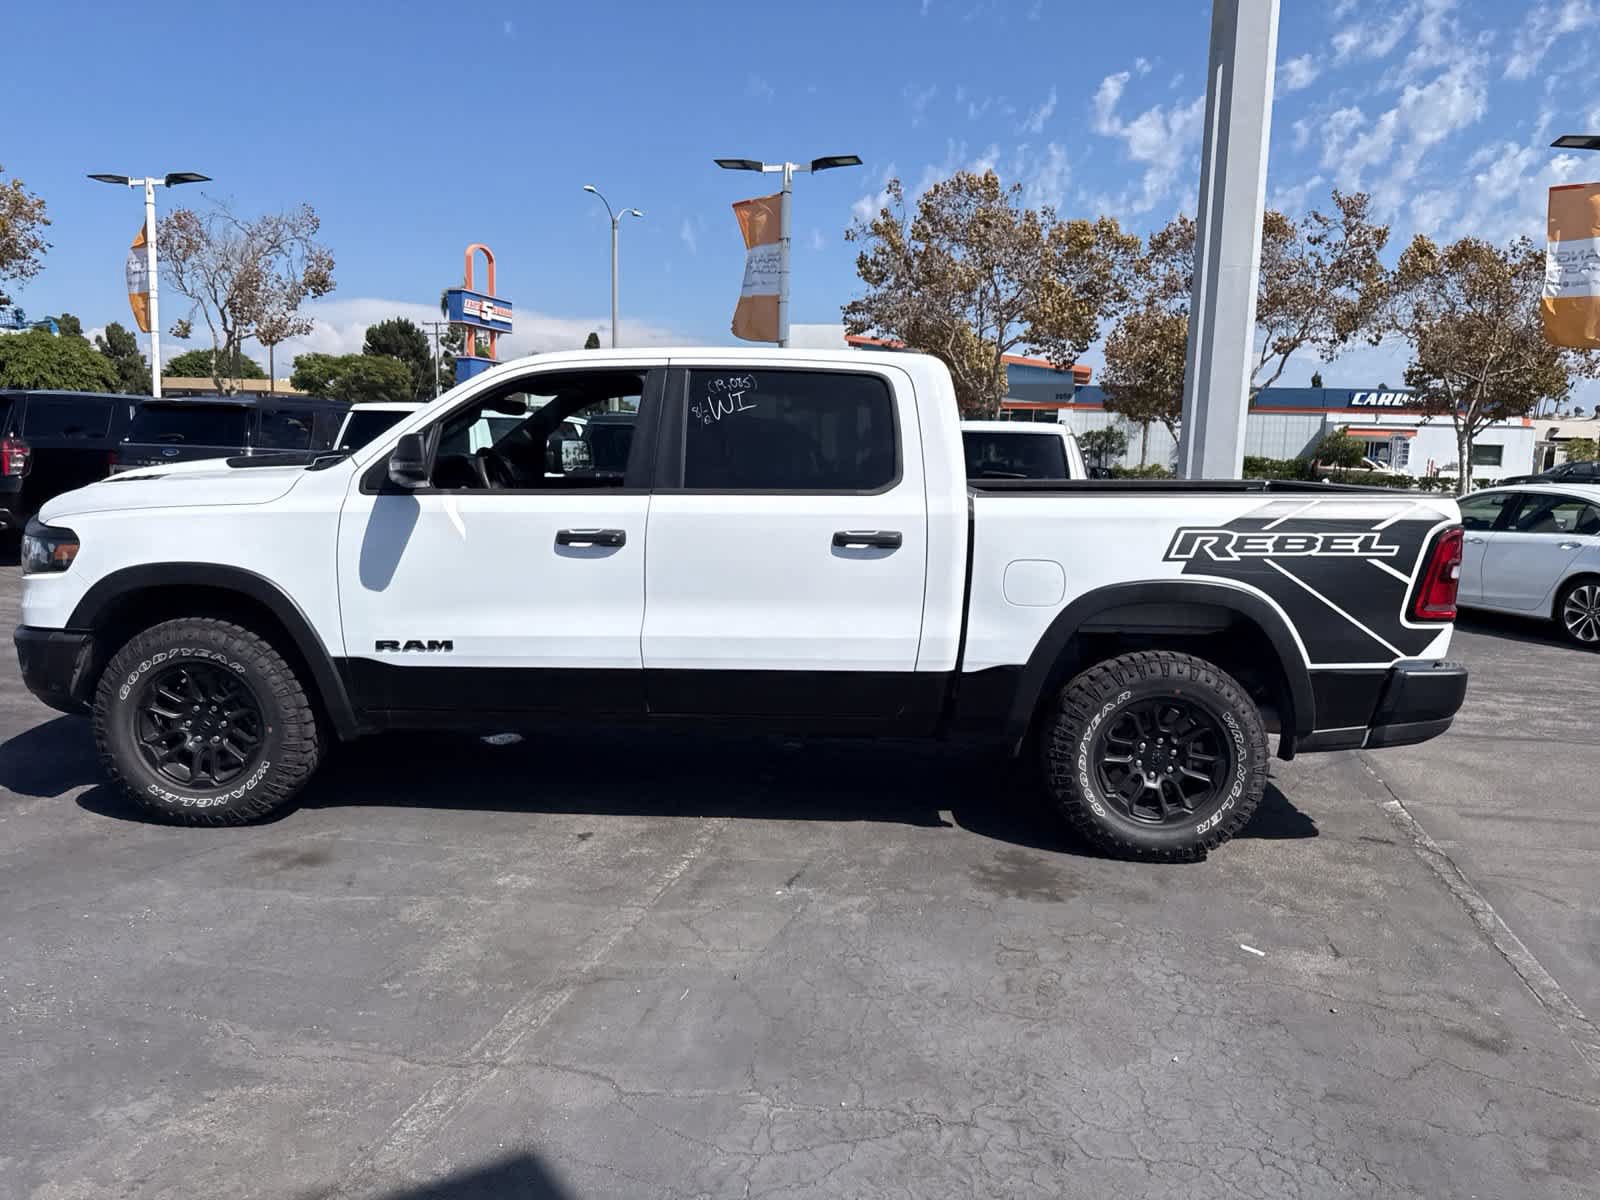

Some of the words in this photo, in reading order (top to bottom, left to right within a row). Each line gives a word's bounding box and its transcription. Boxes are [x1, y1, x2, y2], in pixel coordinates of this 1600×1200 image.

[1169, 529, 1400, 561] REBEL
[375, 640, 453, 653] RAM
[119, 647, 246, 701] GOODYEAR
[1078, 690, 1132, 817] GOODYEAR
[1196, 711, 1248, 835] WRANGLER
[147, 760, 271, 808] WRANGLER
